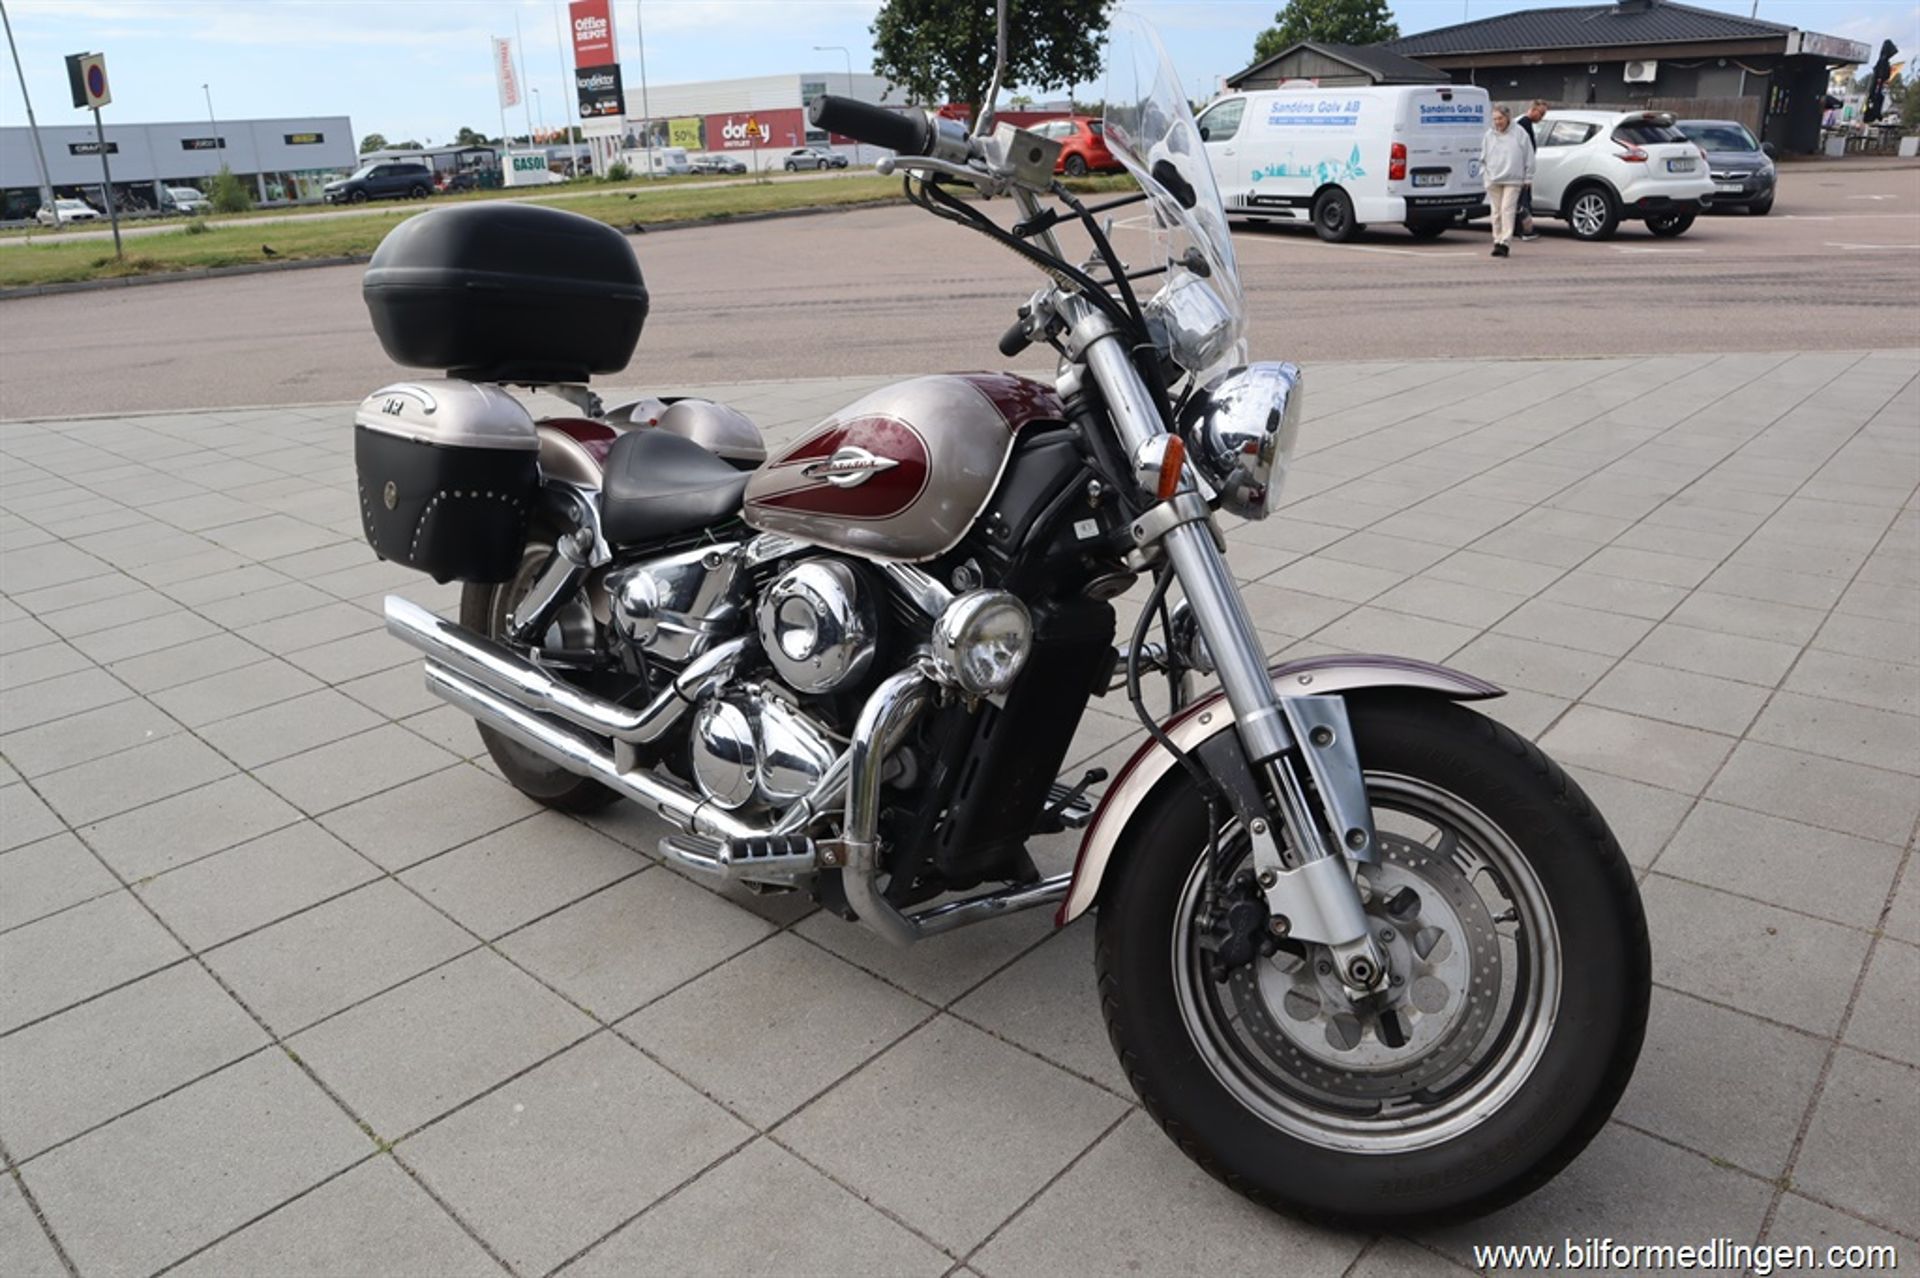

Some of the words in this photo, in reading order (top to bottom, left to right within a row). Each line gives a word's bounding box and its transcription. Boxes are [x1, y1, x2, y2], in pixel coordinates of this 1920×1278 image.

[575, 16, 607, 31] Office
[576, 28, 607, 42] DEPOT
[1344, 100, 1360, 112] AB
[722, 118, 770, 144] dory
[513, 156, 546, 171] GASOL
